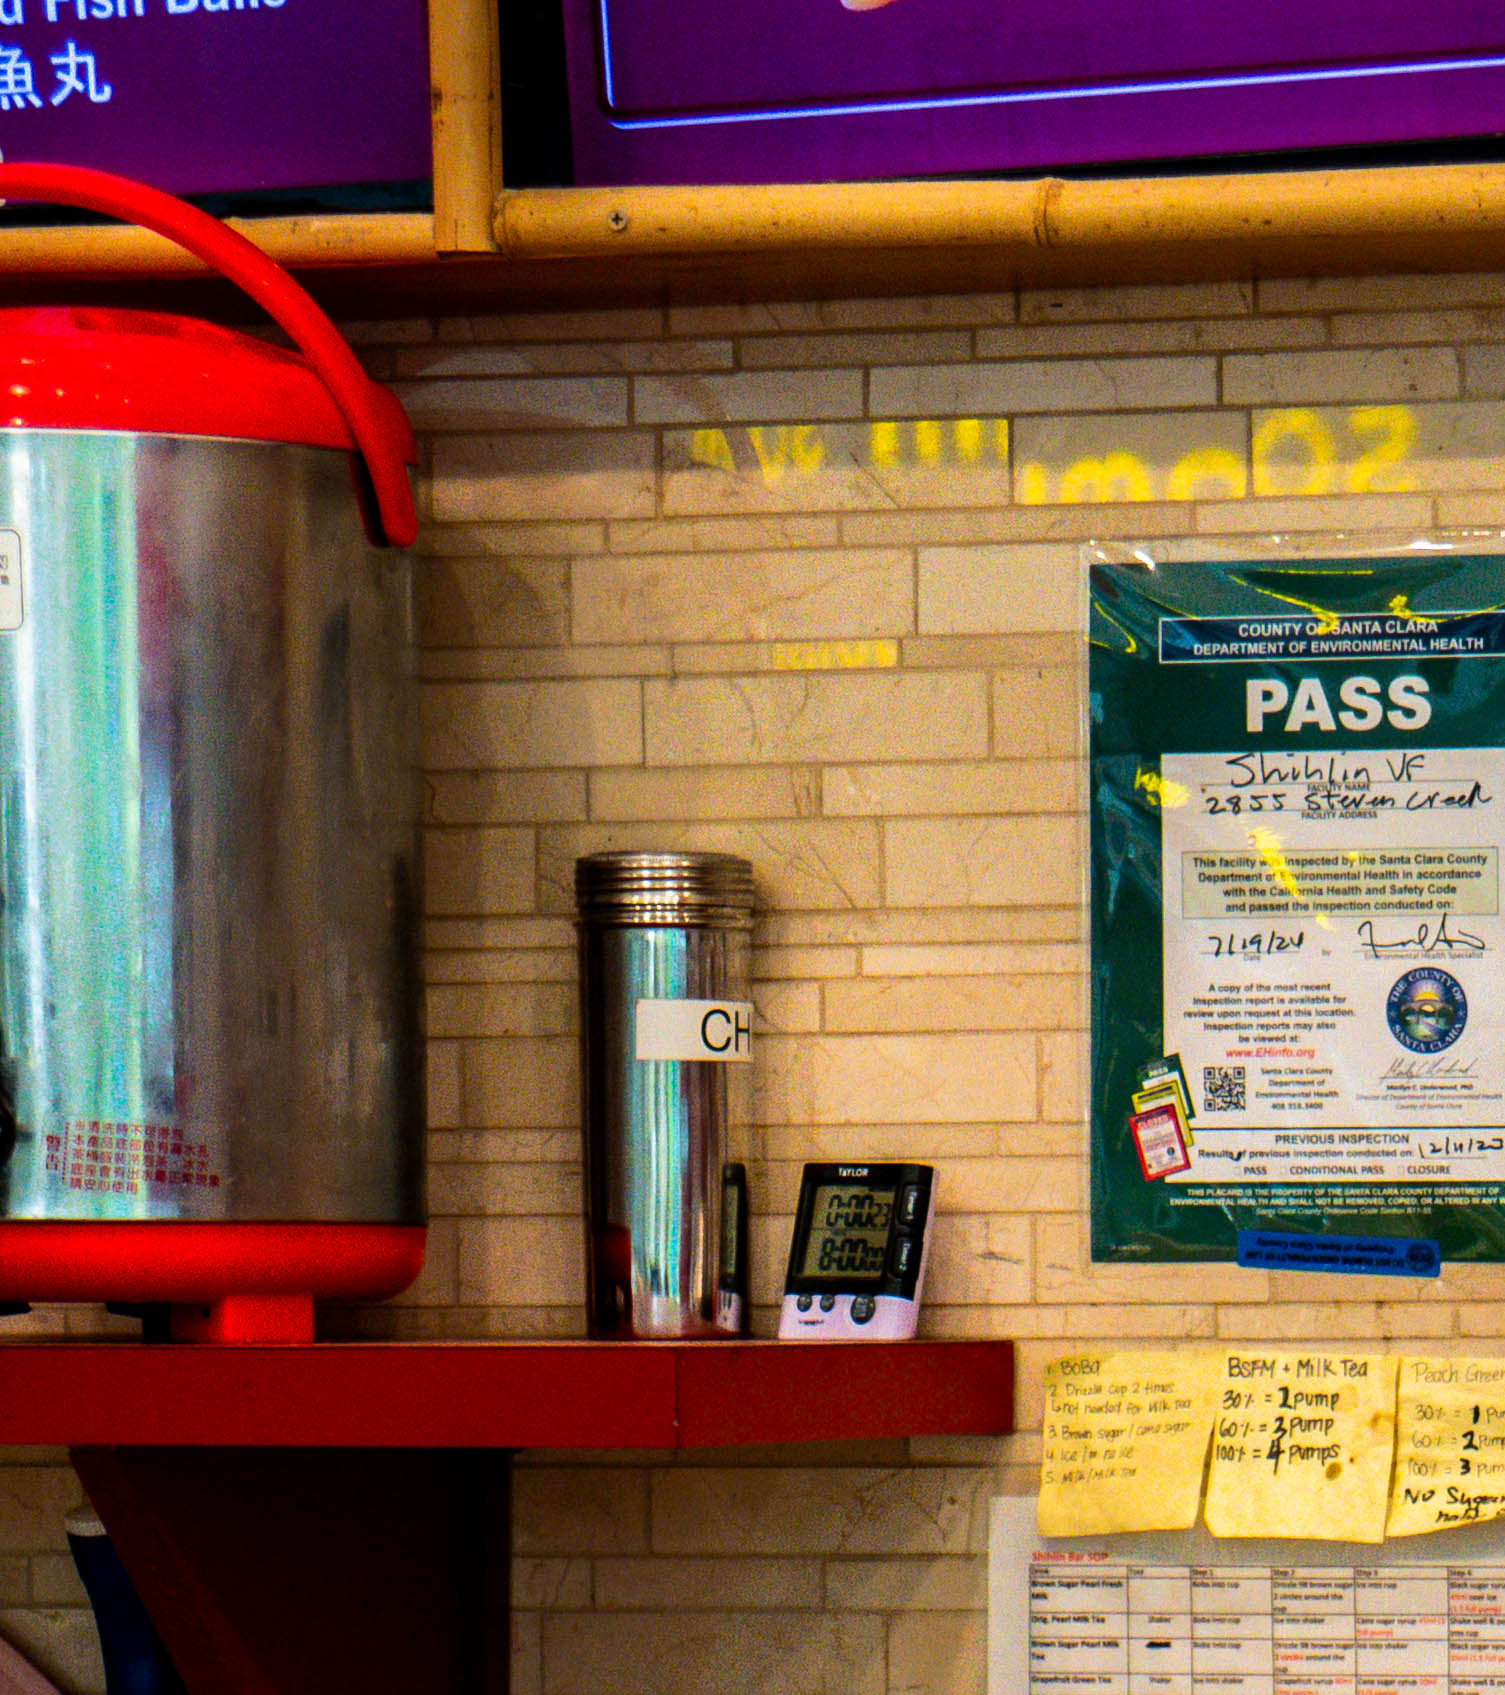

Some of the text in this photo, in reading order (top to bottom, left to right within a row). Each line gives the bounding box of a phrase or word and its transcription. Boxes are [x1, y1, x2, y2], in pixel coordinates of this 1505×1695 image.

[1238, 619, 1439, 638] COUNTY SANTA CLARA
[1193, 637, 1484, 657] DEPARTMENT OF ENVIRONMENTAL HEALTH
[1245, 675, 1433, 733] PASS
[1307, 781, 1371, 793] FACILITY NAME
[1205, 791, 1287, 816] 2855
[1301, 810, 1378, 820] FACILITY ADDRESS
[1193, 856, 1217, 868] This
[1219, 856, 1257, 869] facility
[1285, 855, 1339, 869] inspected
[1358, 855, 1376, 866] the
[1379, 854, 1411, 866] Santa
[1414, 853, 1444, 865] Clara
[1447, 853, 1488, 866] County
[1198, 868, 1482, 884] Department Health in accordance
[1222, 883, 1457, 897] with the Health and Safety Code
[1225, 901, 1246, 912] and
[1249, 901, 1289, 914] passed
[1292, 901, 1309, 912] the
[1312, 899, 1371, 912] inspection
[1373, 899, 1433, 911] conducted
[1208, 983, 1331, 994] A copy of the most recent
[1245, 997, 1274, 1007] report
[1288, 996, 1330, 1004] available
[1333, 995, 1347, 1004] for
[1183, 1010, 1214, 1018] review
[1217, 1011, 1241, 1020] upon
[1244, 1010, 1281, 1019] request
[1294, 1009, 1312, 1017] this
[1314, 1008, 1357, 1017] location.
[1203, 1022, 1336, 1032] Inspection reports may also
[1238, 1034, 1286, 1043] be viewed
[1225, 1048, 1316, 1060] www.EHinfo.org
[1275, 1133, 1410, 1145] PREVIOUS INSPECTION
[1198, 1149, 1234, 1158] Results
[1249, 1150, 1291, 1160] previous
[1346, 1149, 1397, 1158] conducted
[838, 1167, 870, 1178] TAYLOR
[1243, 1164, 1451, 1176] PASS CONDITIONAL PASS CLOSURE
[1339, 1358, 1369, 1378] Tea
[1411, 1361, 1459, 1384] Peach
